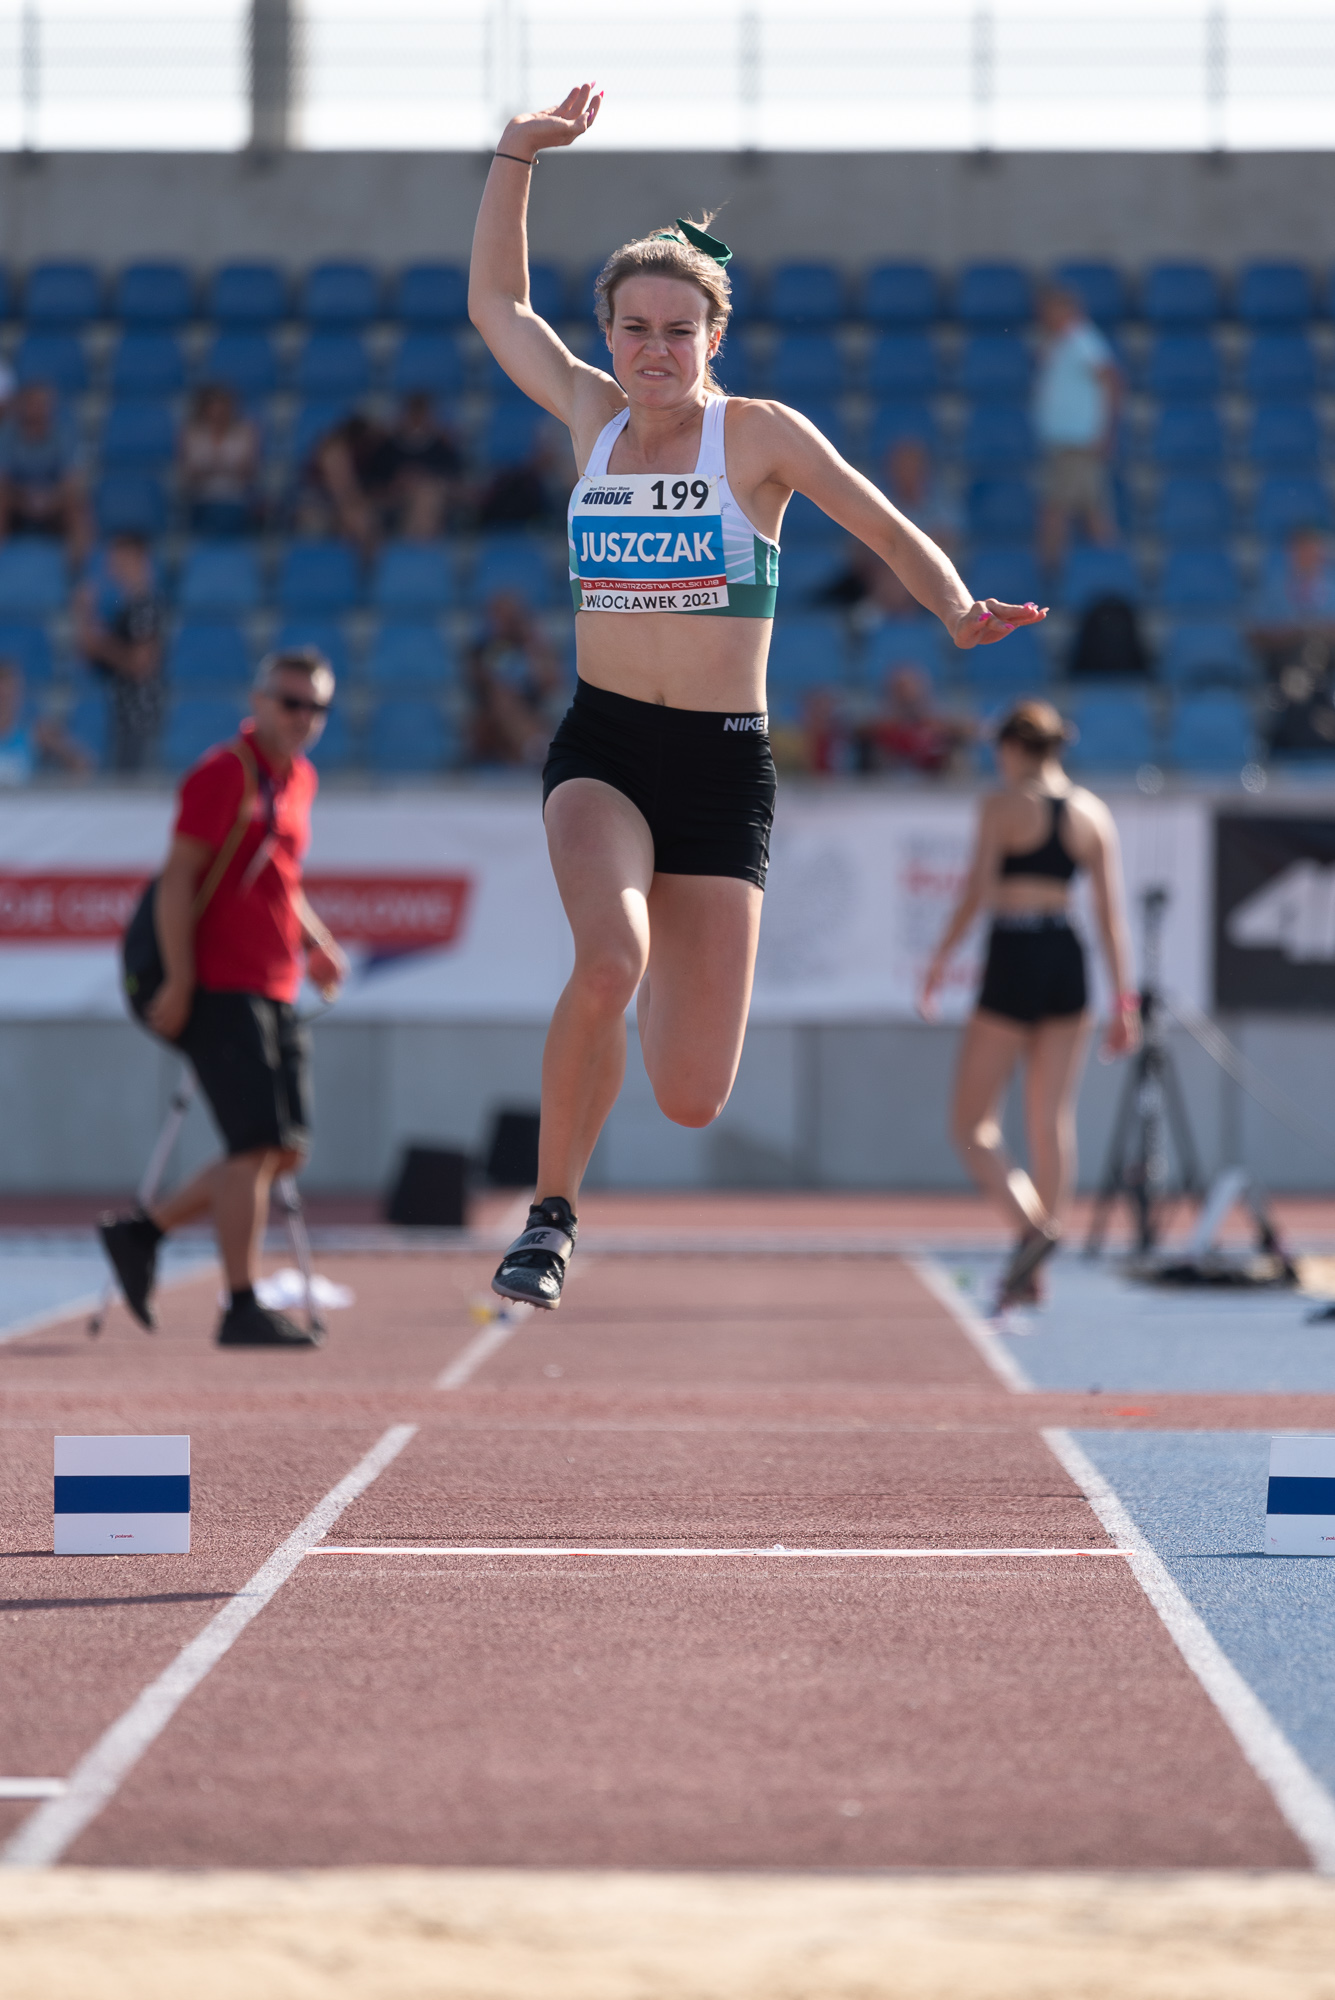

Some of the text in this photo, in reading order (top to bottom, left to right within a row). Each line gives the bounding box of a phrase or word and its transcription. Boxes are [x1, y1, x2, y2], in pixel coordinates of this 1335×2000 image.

[581, 491, 634, 505] 4MOVE
[650, 480, 709, 510] 199
[580, 531, 717, 563] JUSZCZAK
[615, 582, 671, 590] MISTRZOSTWA
[672, 581, 702, 589] POLSKI
[585, 591, 719, 609] WŁOCŁAWEK 2021
[723, 716, 764, 731] NIKE
